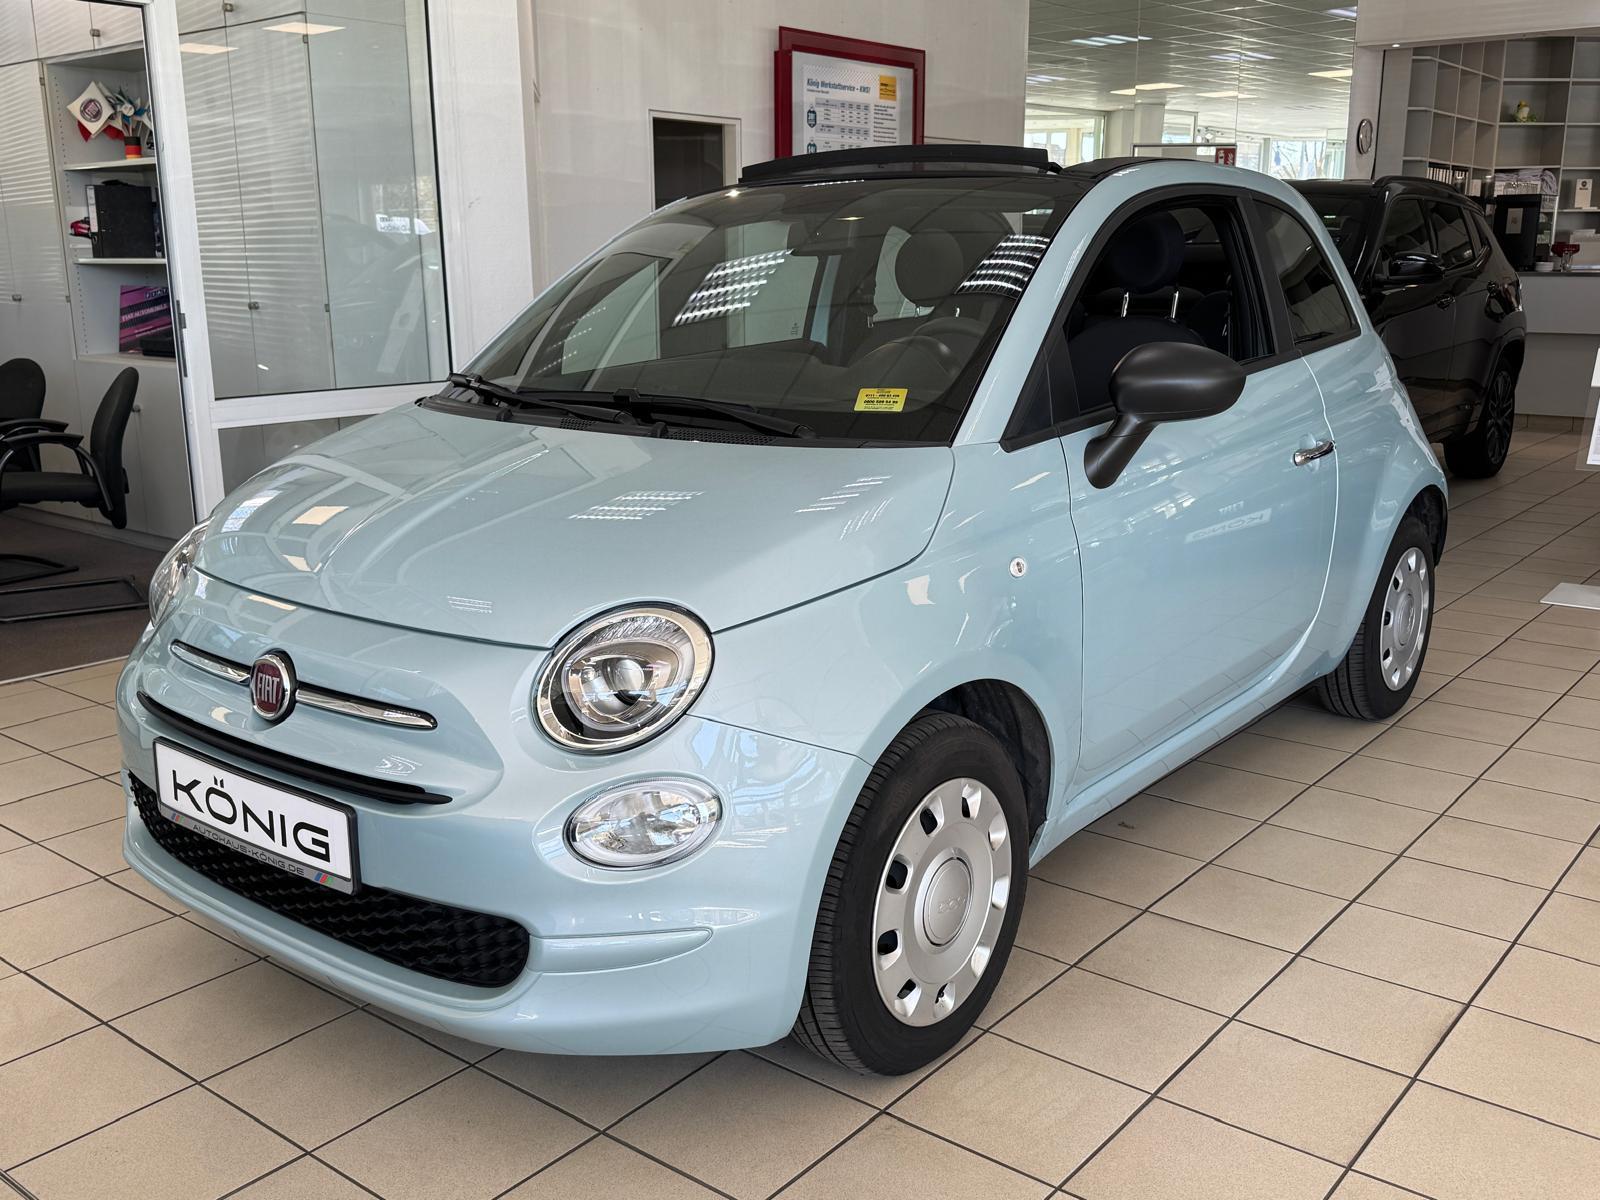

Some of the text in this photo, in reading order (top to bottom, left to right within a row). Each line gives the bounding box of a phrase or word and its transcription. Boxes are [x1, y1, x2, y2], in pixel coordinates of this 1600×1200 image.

[256, 672, 280, 705] FIAT
[171, 768, 331, 863] KÖNIG
[191, 823, 305, 876] AUTOHAUS-KÖNIG.DE
